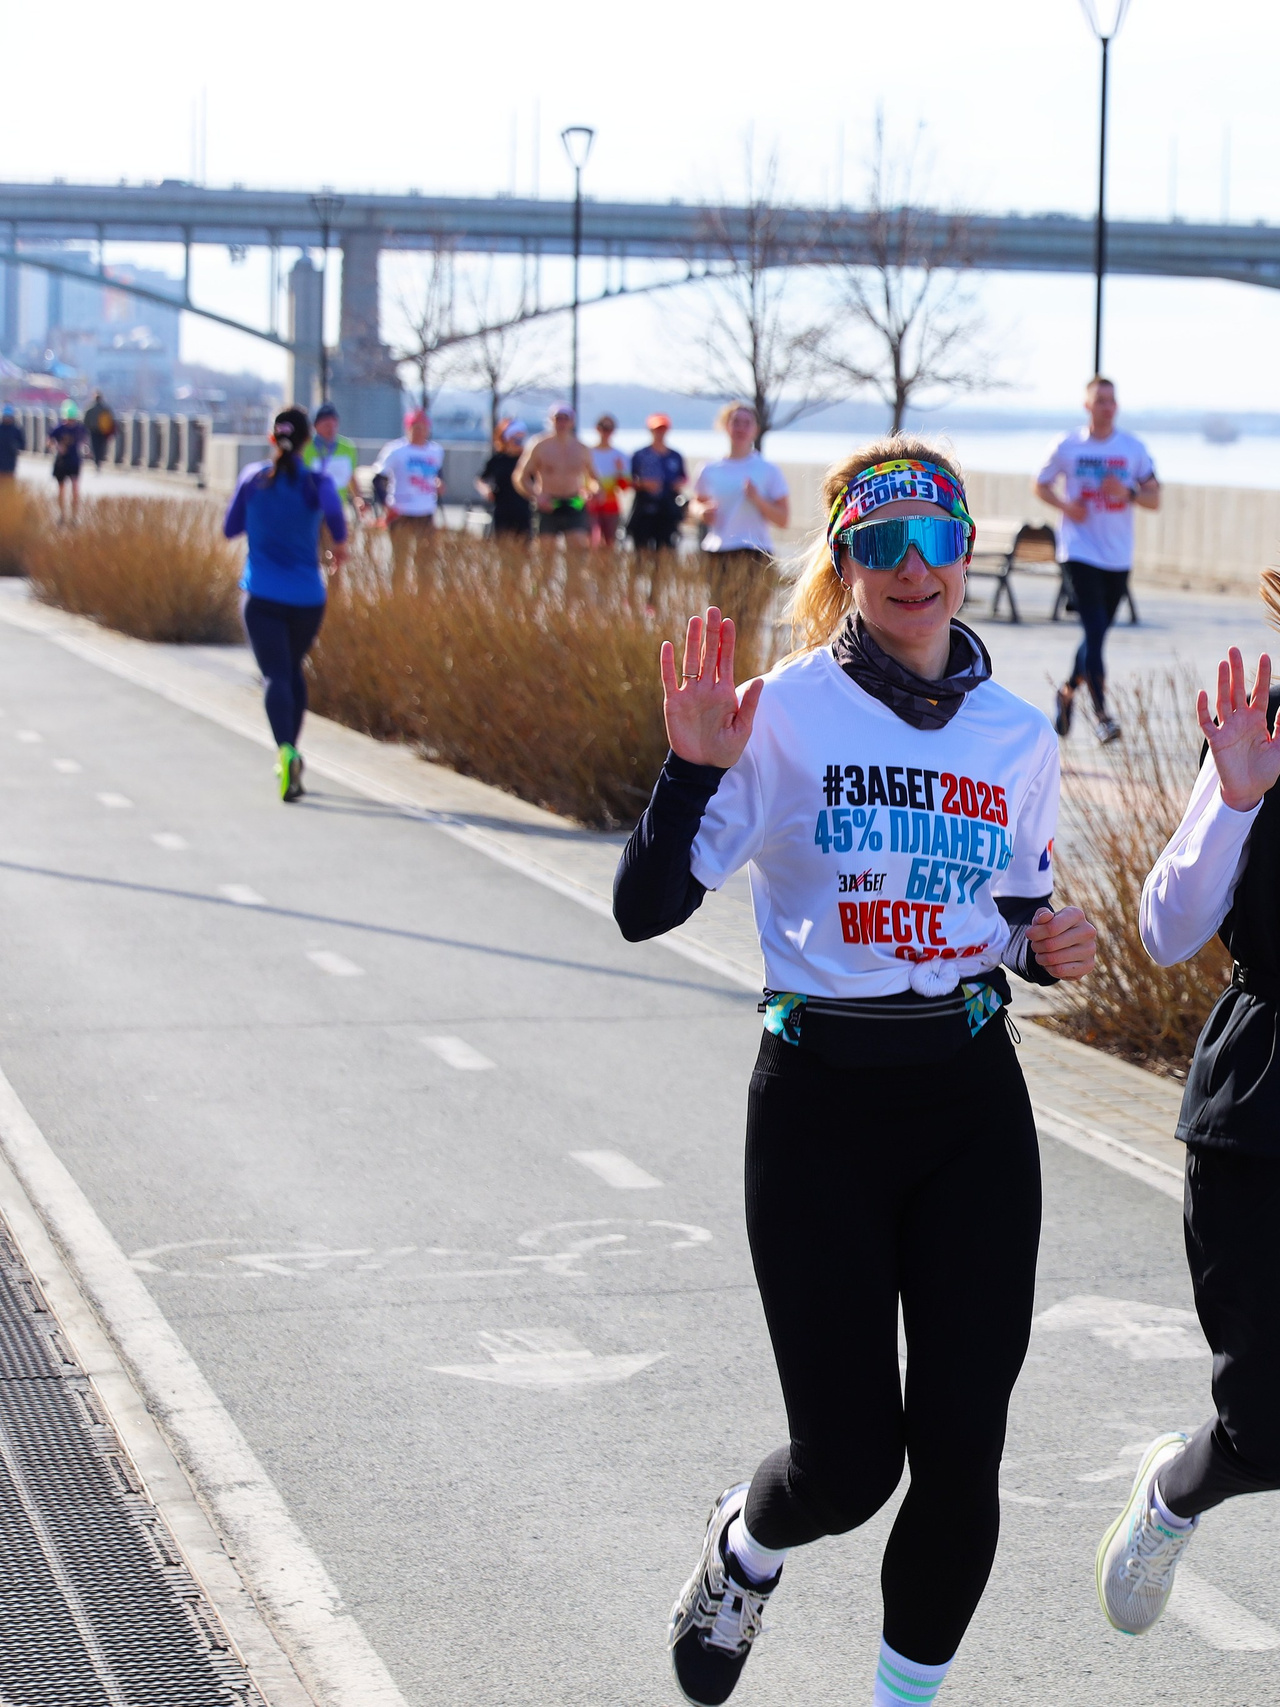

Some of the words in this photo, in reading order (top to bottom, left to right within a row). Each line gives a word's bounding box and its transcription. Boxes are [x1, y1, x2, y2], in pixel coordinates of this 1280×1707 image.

[860, 480, 934, 513] СОЮЗ
[814, 808, 883, 854] 45%
[889, 809, 1013, 872] ПЛАНЕТЫ
[905, 857, 992, 905] БЕГУТ
[838, 899, 947, 946] ВМЕСТЕ
